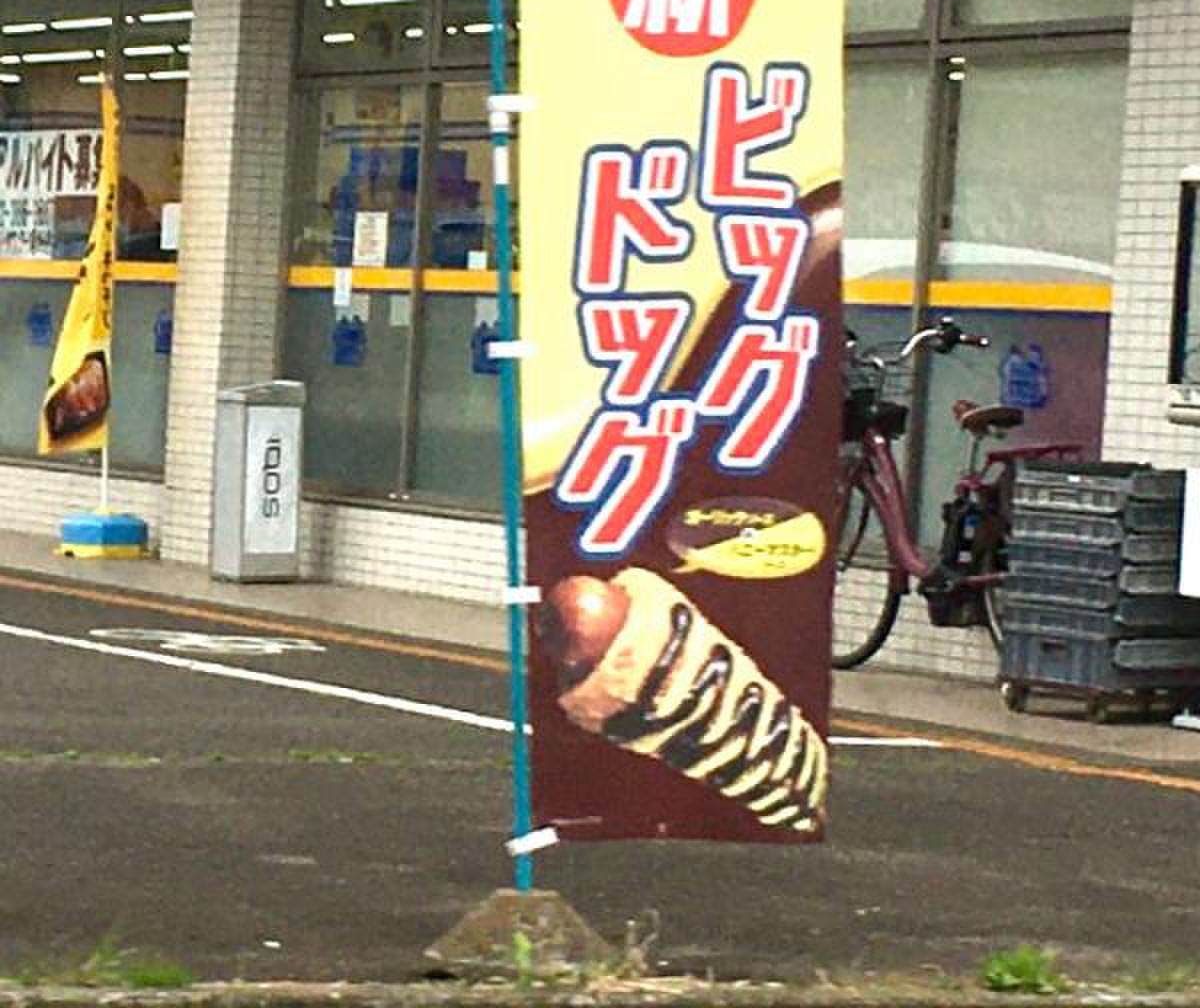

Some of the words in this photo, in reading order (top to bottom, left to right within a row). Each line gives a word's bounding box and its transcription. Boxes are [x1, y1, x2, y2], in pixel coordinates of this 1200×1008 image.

[560, 141, 696, 555] ドッグ
[702, 62, 818, 469] ビッグ
